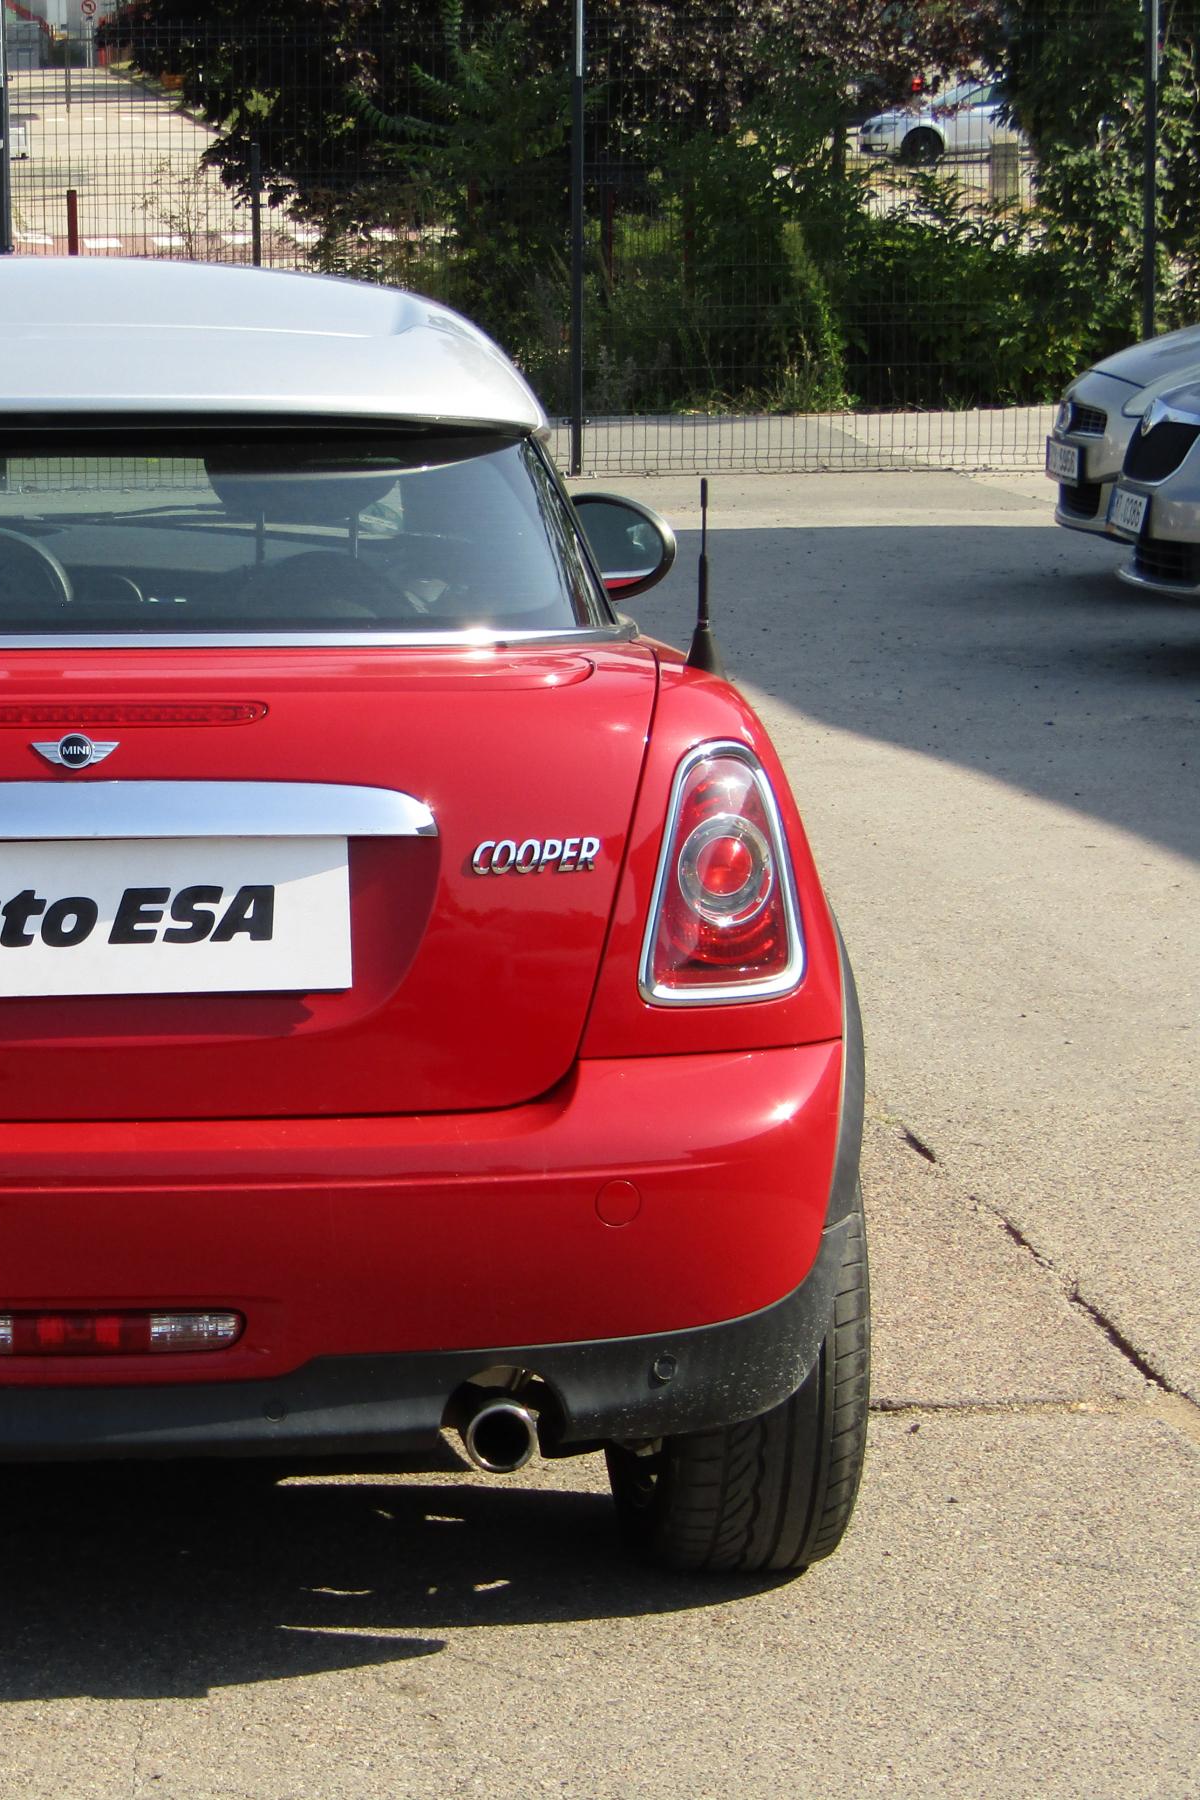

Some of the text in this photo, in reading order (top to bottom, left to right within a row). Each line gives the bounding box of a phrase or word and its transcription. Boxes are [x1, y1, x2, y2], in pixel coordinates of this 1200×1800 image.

[62, 745, 90, 755] MINI
[472, 837, 601, 875] COOPER
[108, 884, 275, 945] ESA
